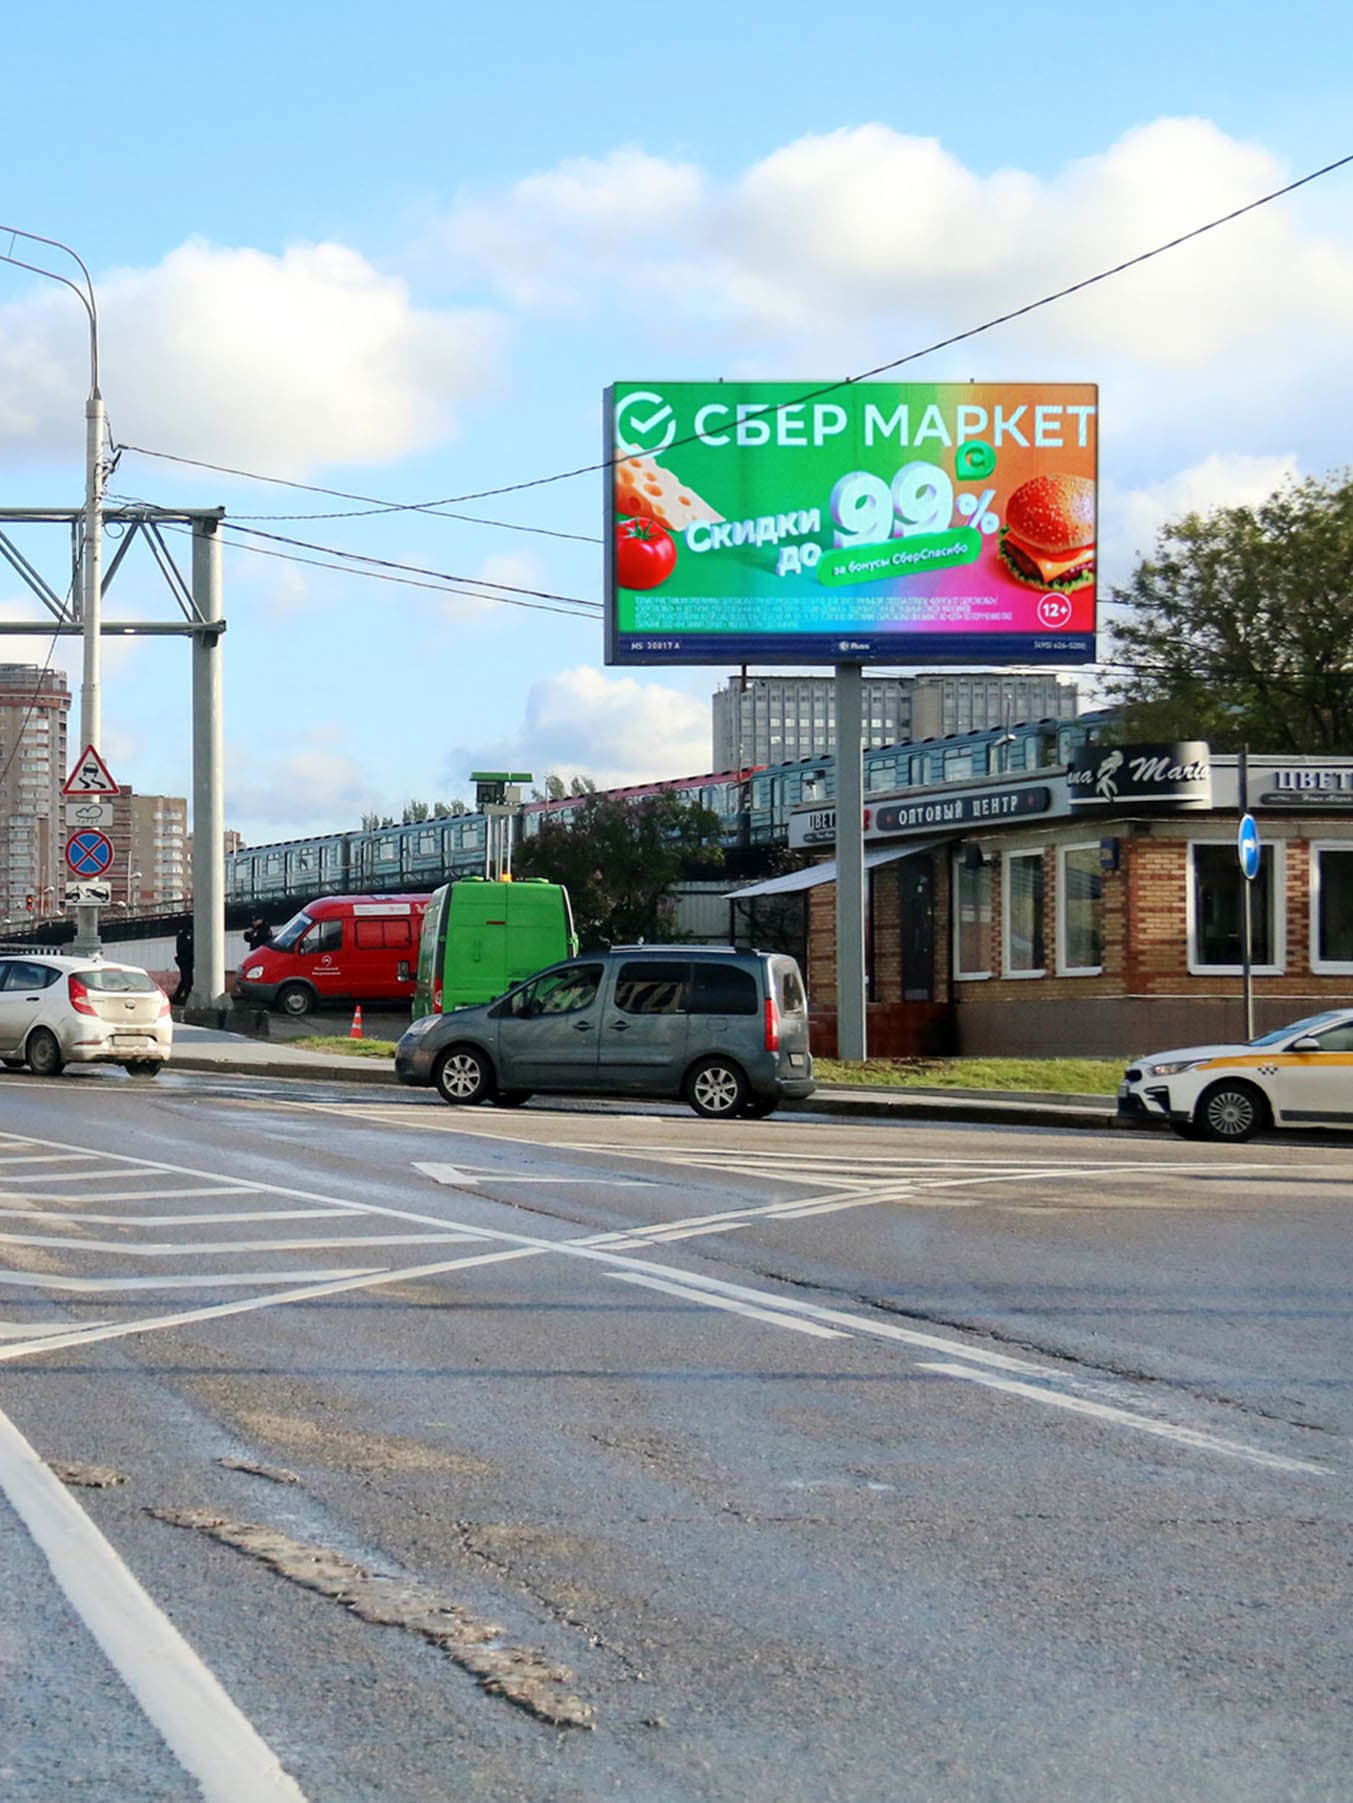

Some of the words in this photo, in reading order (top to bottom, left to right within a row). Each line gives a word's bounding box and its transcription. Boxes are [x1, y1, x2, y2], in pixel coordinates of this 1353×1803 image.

[694, 403, 848, 447] СБЕР
[864, 403, 1096, 448] МАРКЕТ
[685, 508, 821, 552] Скидки
[832, 564, 847, 577] за
[847, 556, 889, 575] бонусы
[891, 543, 969, 567] СберСпасибо
[1043, 603, 1069, 618] 12+
[899, 800, 964, 826] ОПТОВЫЙ
[972, 794, 1019, 817] ЦЕНТР
